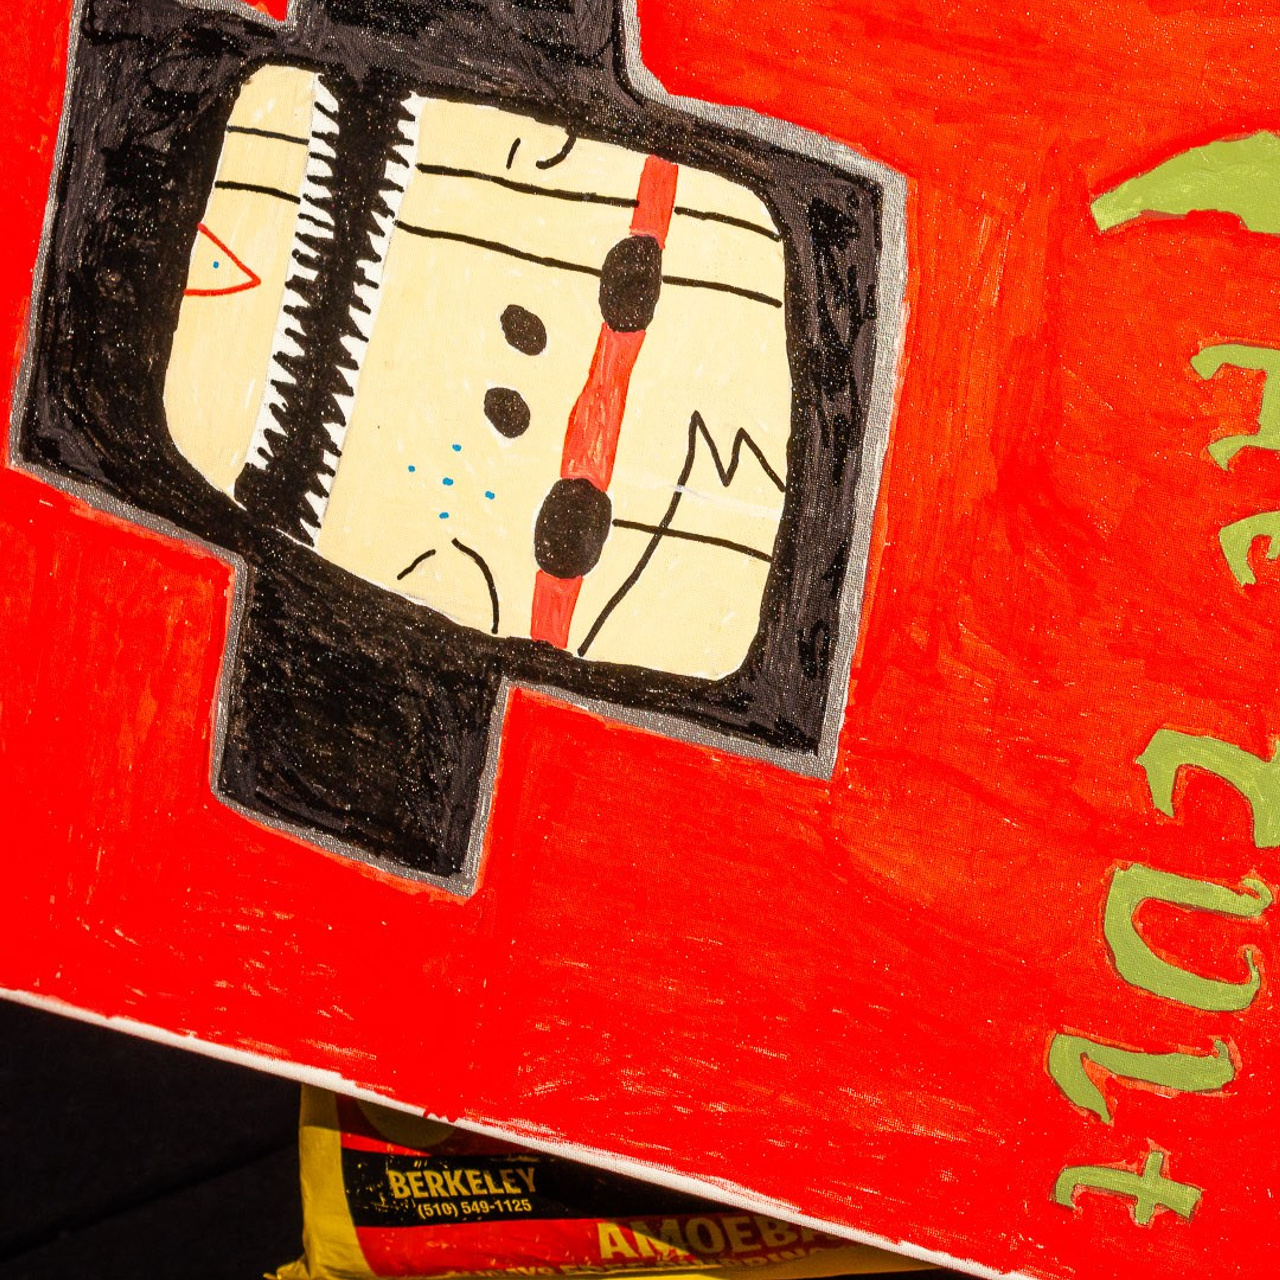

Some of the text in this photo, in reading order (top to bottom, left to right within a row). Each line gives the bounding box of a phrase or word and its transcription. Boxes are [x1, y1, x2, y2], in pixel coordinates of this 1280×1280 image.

[388, 1166, 537, 1200] BERKELEY
[417, 1198, 532, 1220] (510) 549-1125
